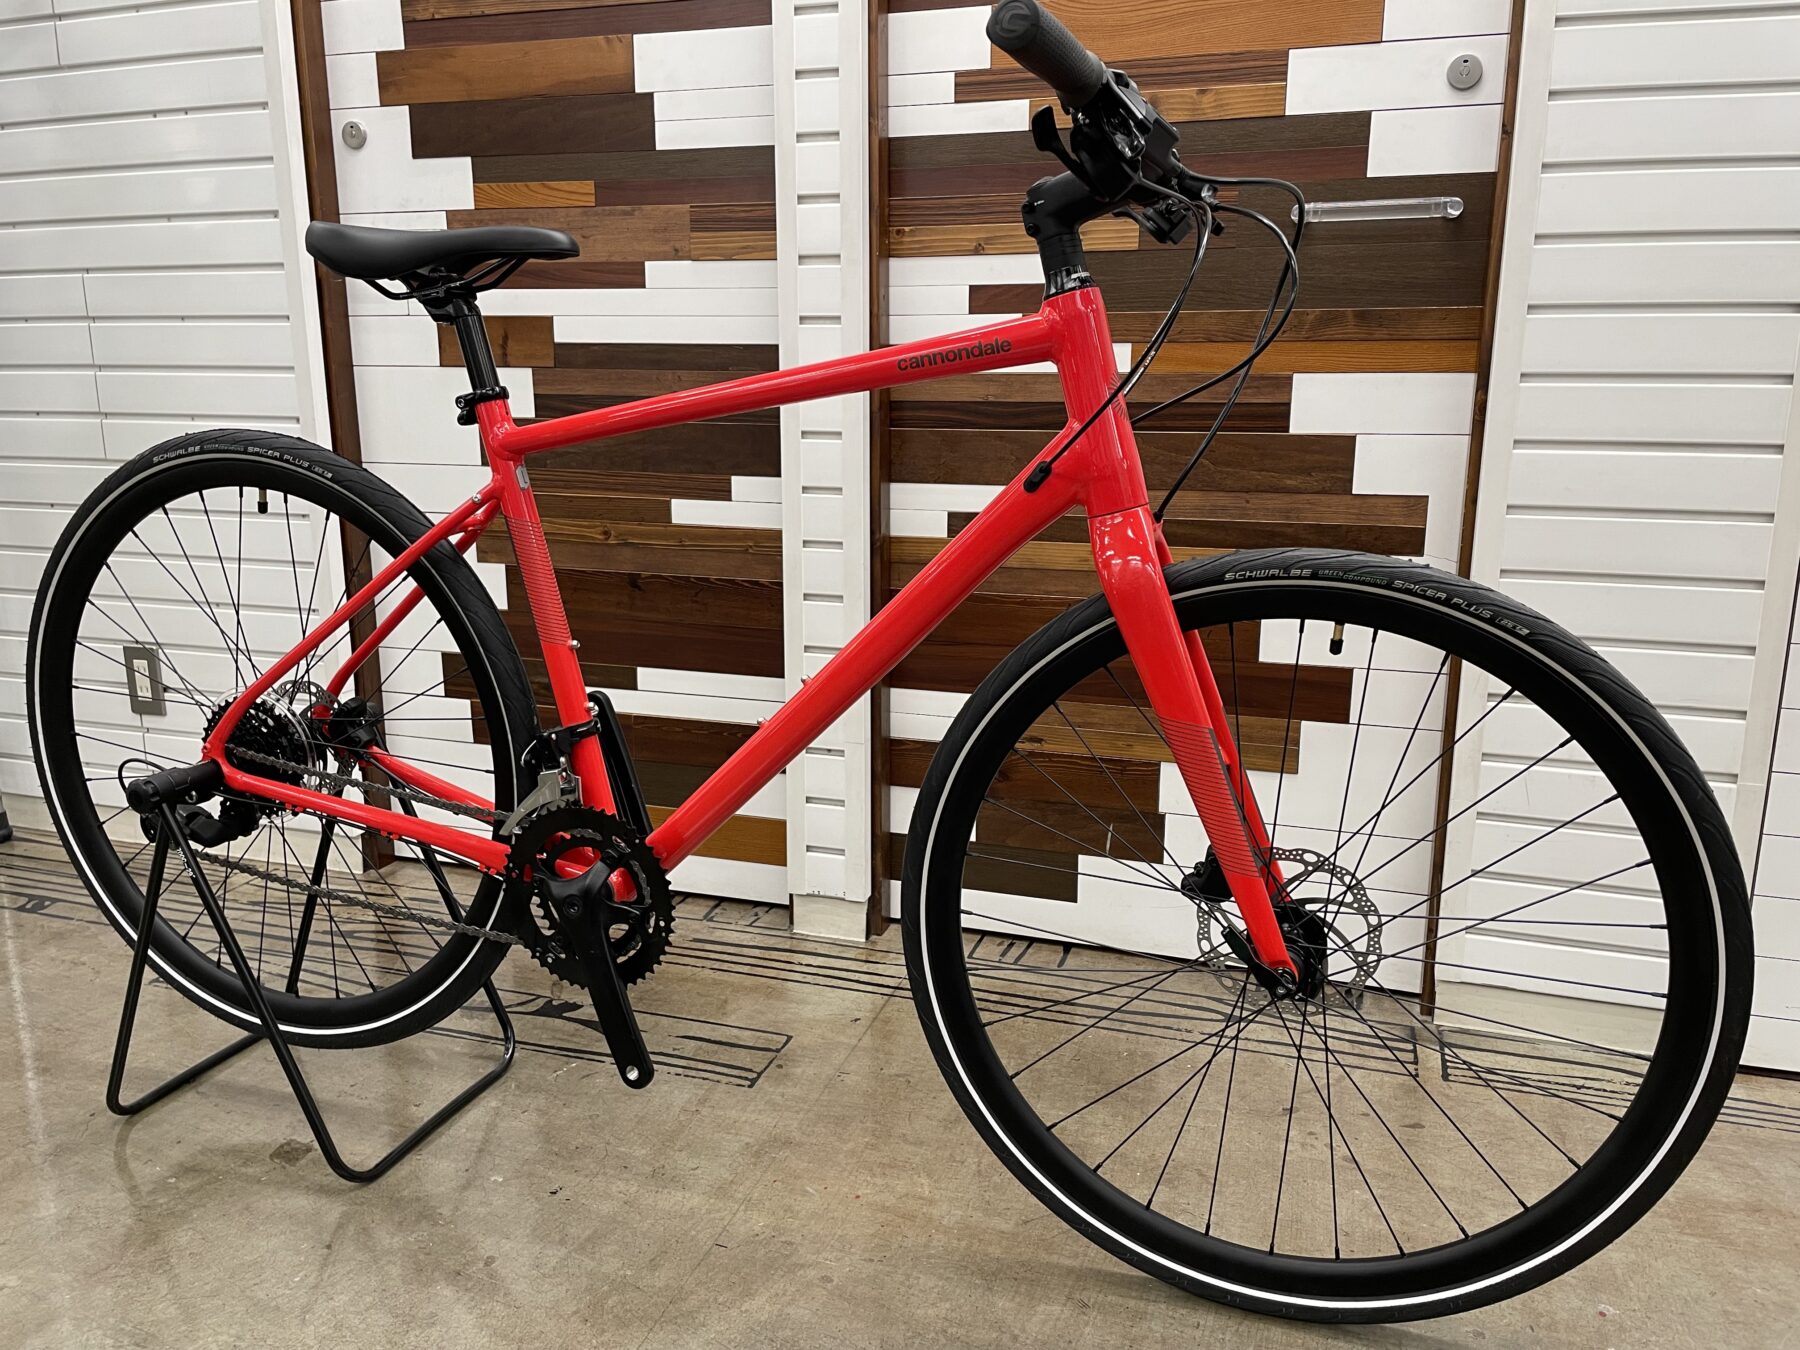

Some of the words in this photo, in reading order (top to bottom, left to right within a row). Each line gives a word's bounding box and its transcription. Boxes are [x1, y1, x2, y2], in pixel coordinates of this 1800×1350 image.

[897, 338, 1012, 371] cannondale
[152, 445, 200, 464] SCHWALBE
[247, 446, 280, 459] SPICER
[283, 454, 310, 468] PLUS
[1224, 569, 1313, 581] SCHWALBE
[1343, 574, 1388, 585] COMPOUND
[1392, 580, 1448, 601] SPICER
[1450, 597, 1494, 619] PLUS
